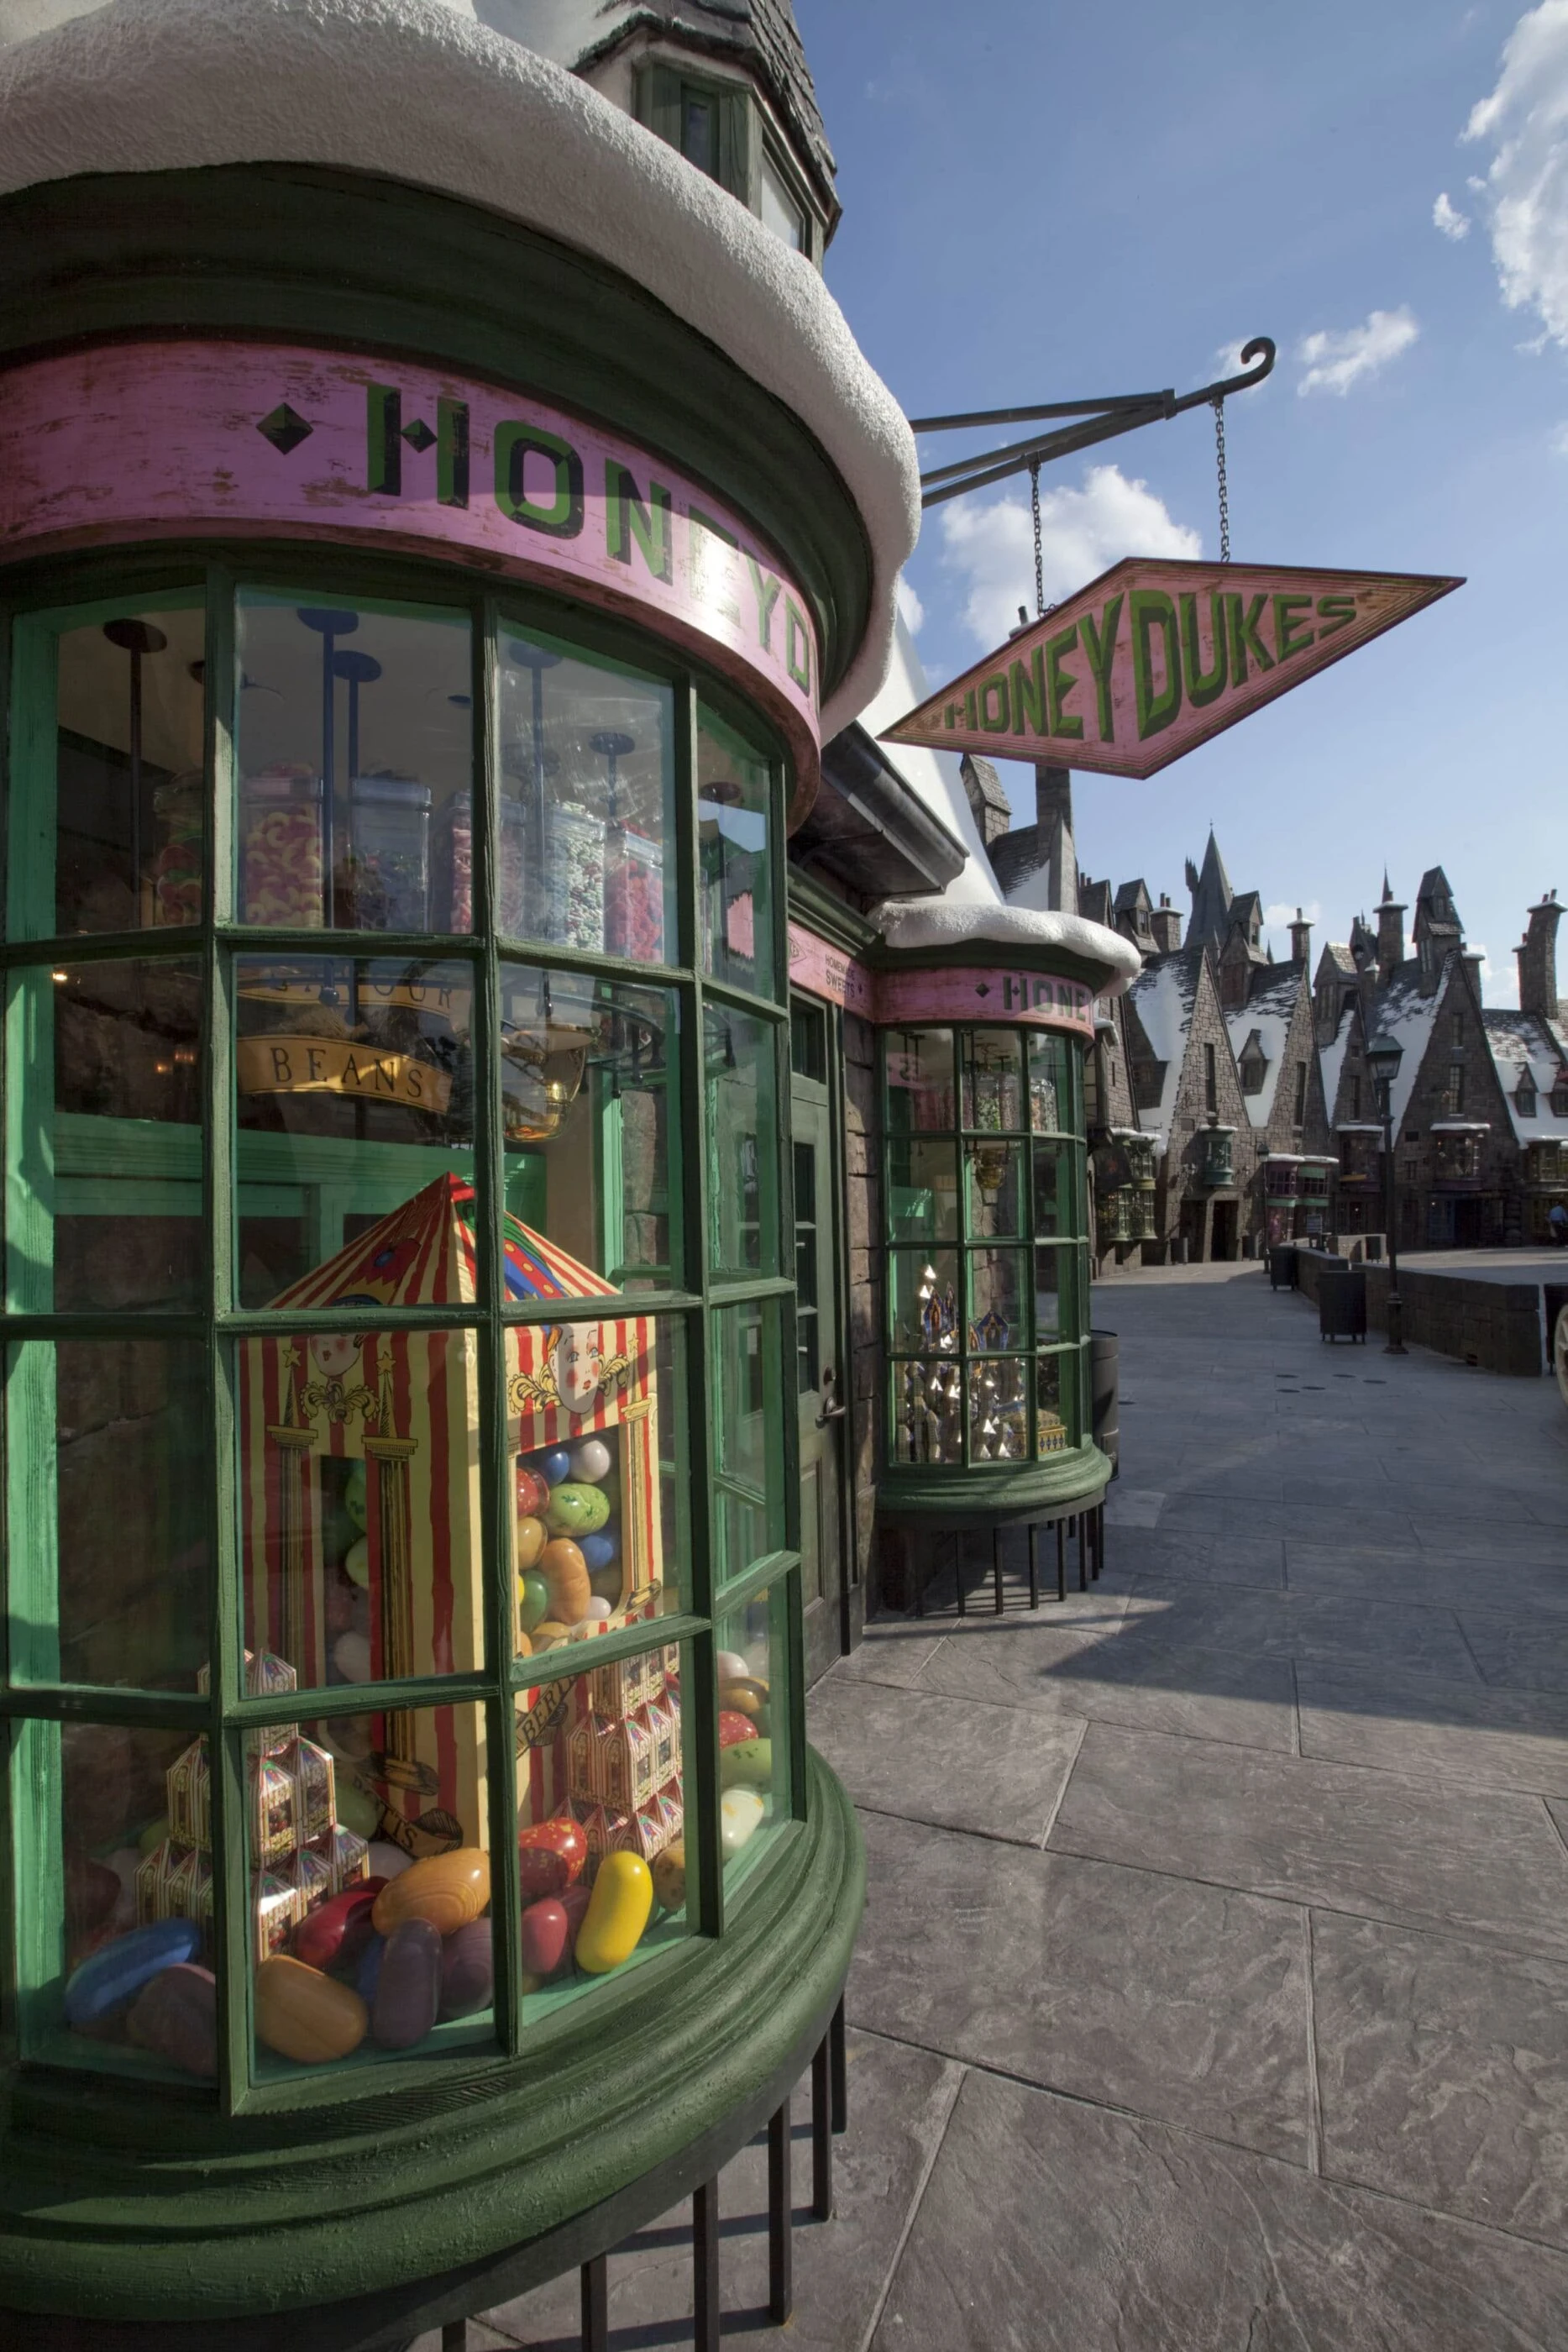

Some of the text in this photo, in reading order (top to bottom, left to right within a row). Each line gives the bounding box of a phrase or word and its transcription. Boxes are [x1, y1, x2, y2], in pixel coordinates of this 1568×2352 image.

[944, 589, 1357, 743] HONEYDUKES
[826, 969, 855, 999] SWEETS
[270, 1047, 422, 1098] BEANS
